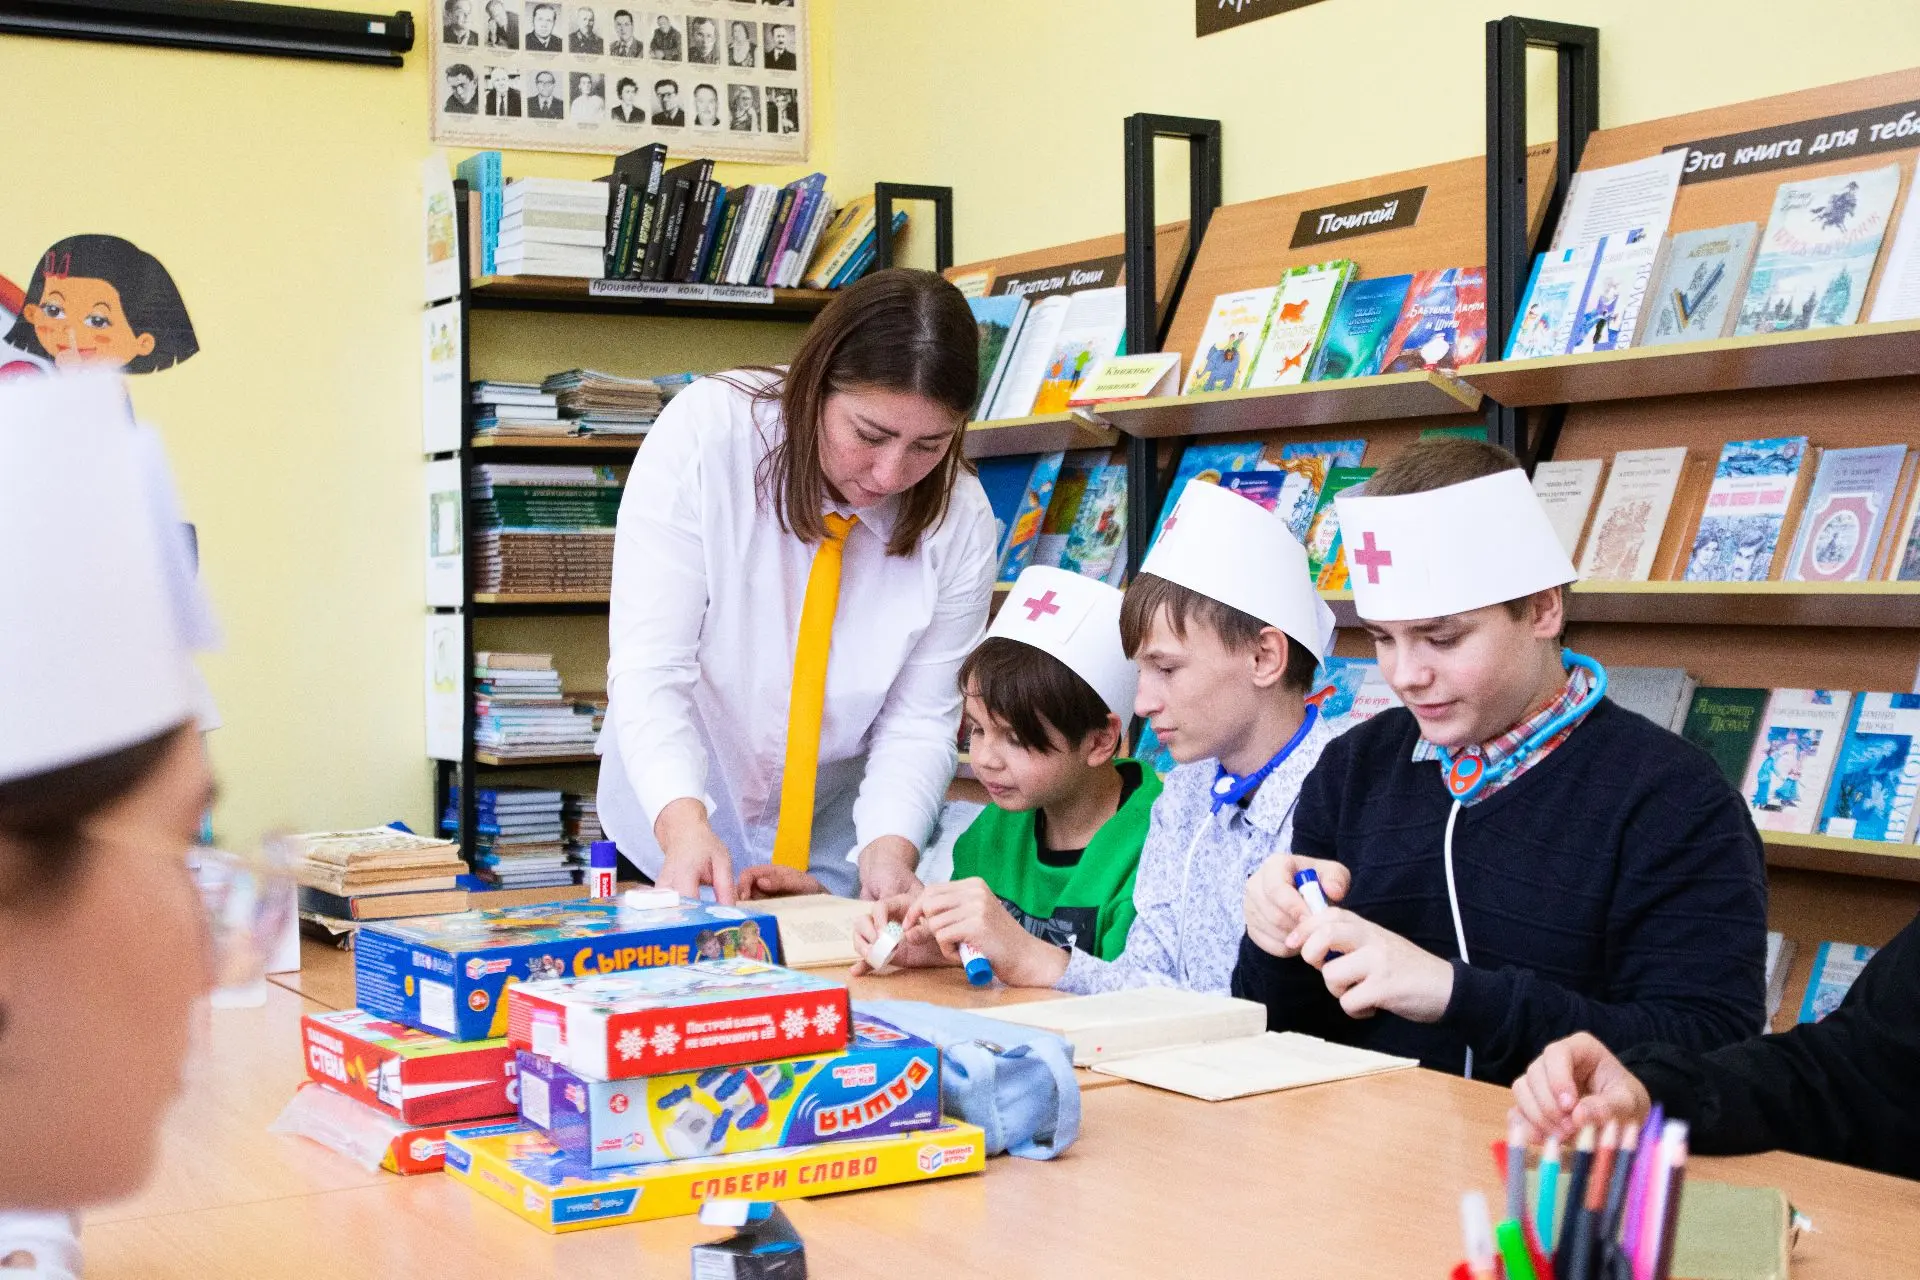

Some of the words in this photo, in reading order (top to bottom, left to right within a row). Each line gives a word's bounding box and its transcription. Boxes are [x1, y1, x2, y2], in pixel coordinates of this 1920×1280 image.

[1684, 150, 1725, 174] Эта
[1734, 138, 1800, 165] книга
[1809, 128, 1858, 157] для
[1869, 110, 1920, 143] тебя
[613, 183, 628, 228] РАЗМЫСЛОВ
[1316, 199, 1399, 235] Почитай!
[592, 280, 668, 294] Произведения
[677, 285, 704, 296] коми
[712, 287, 769, 300] писателей
[1004, 275, 1066, 296] Писатели
[1068, 269, 1105, 287] Коми
[1617, 262, 1652, 350] ФРЕМОВ
[1105, 366, 1155, 376] Книжные
[1696, 698, 1756, 717] Александр
[1707, 716, 1749, 733] Дюма
[572, 943, 690, 978] СЫРНЫЕ
[310, 1046, 348, 1084] СТЕНА
[817, 1059, 930, 1133] БАШНЯ
[690, 1168, 788, 1201] СОБЕРИ
[798, 1155, 878, 1186] СЛОВО
